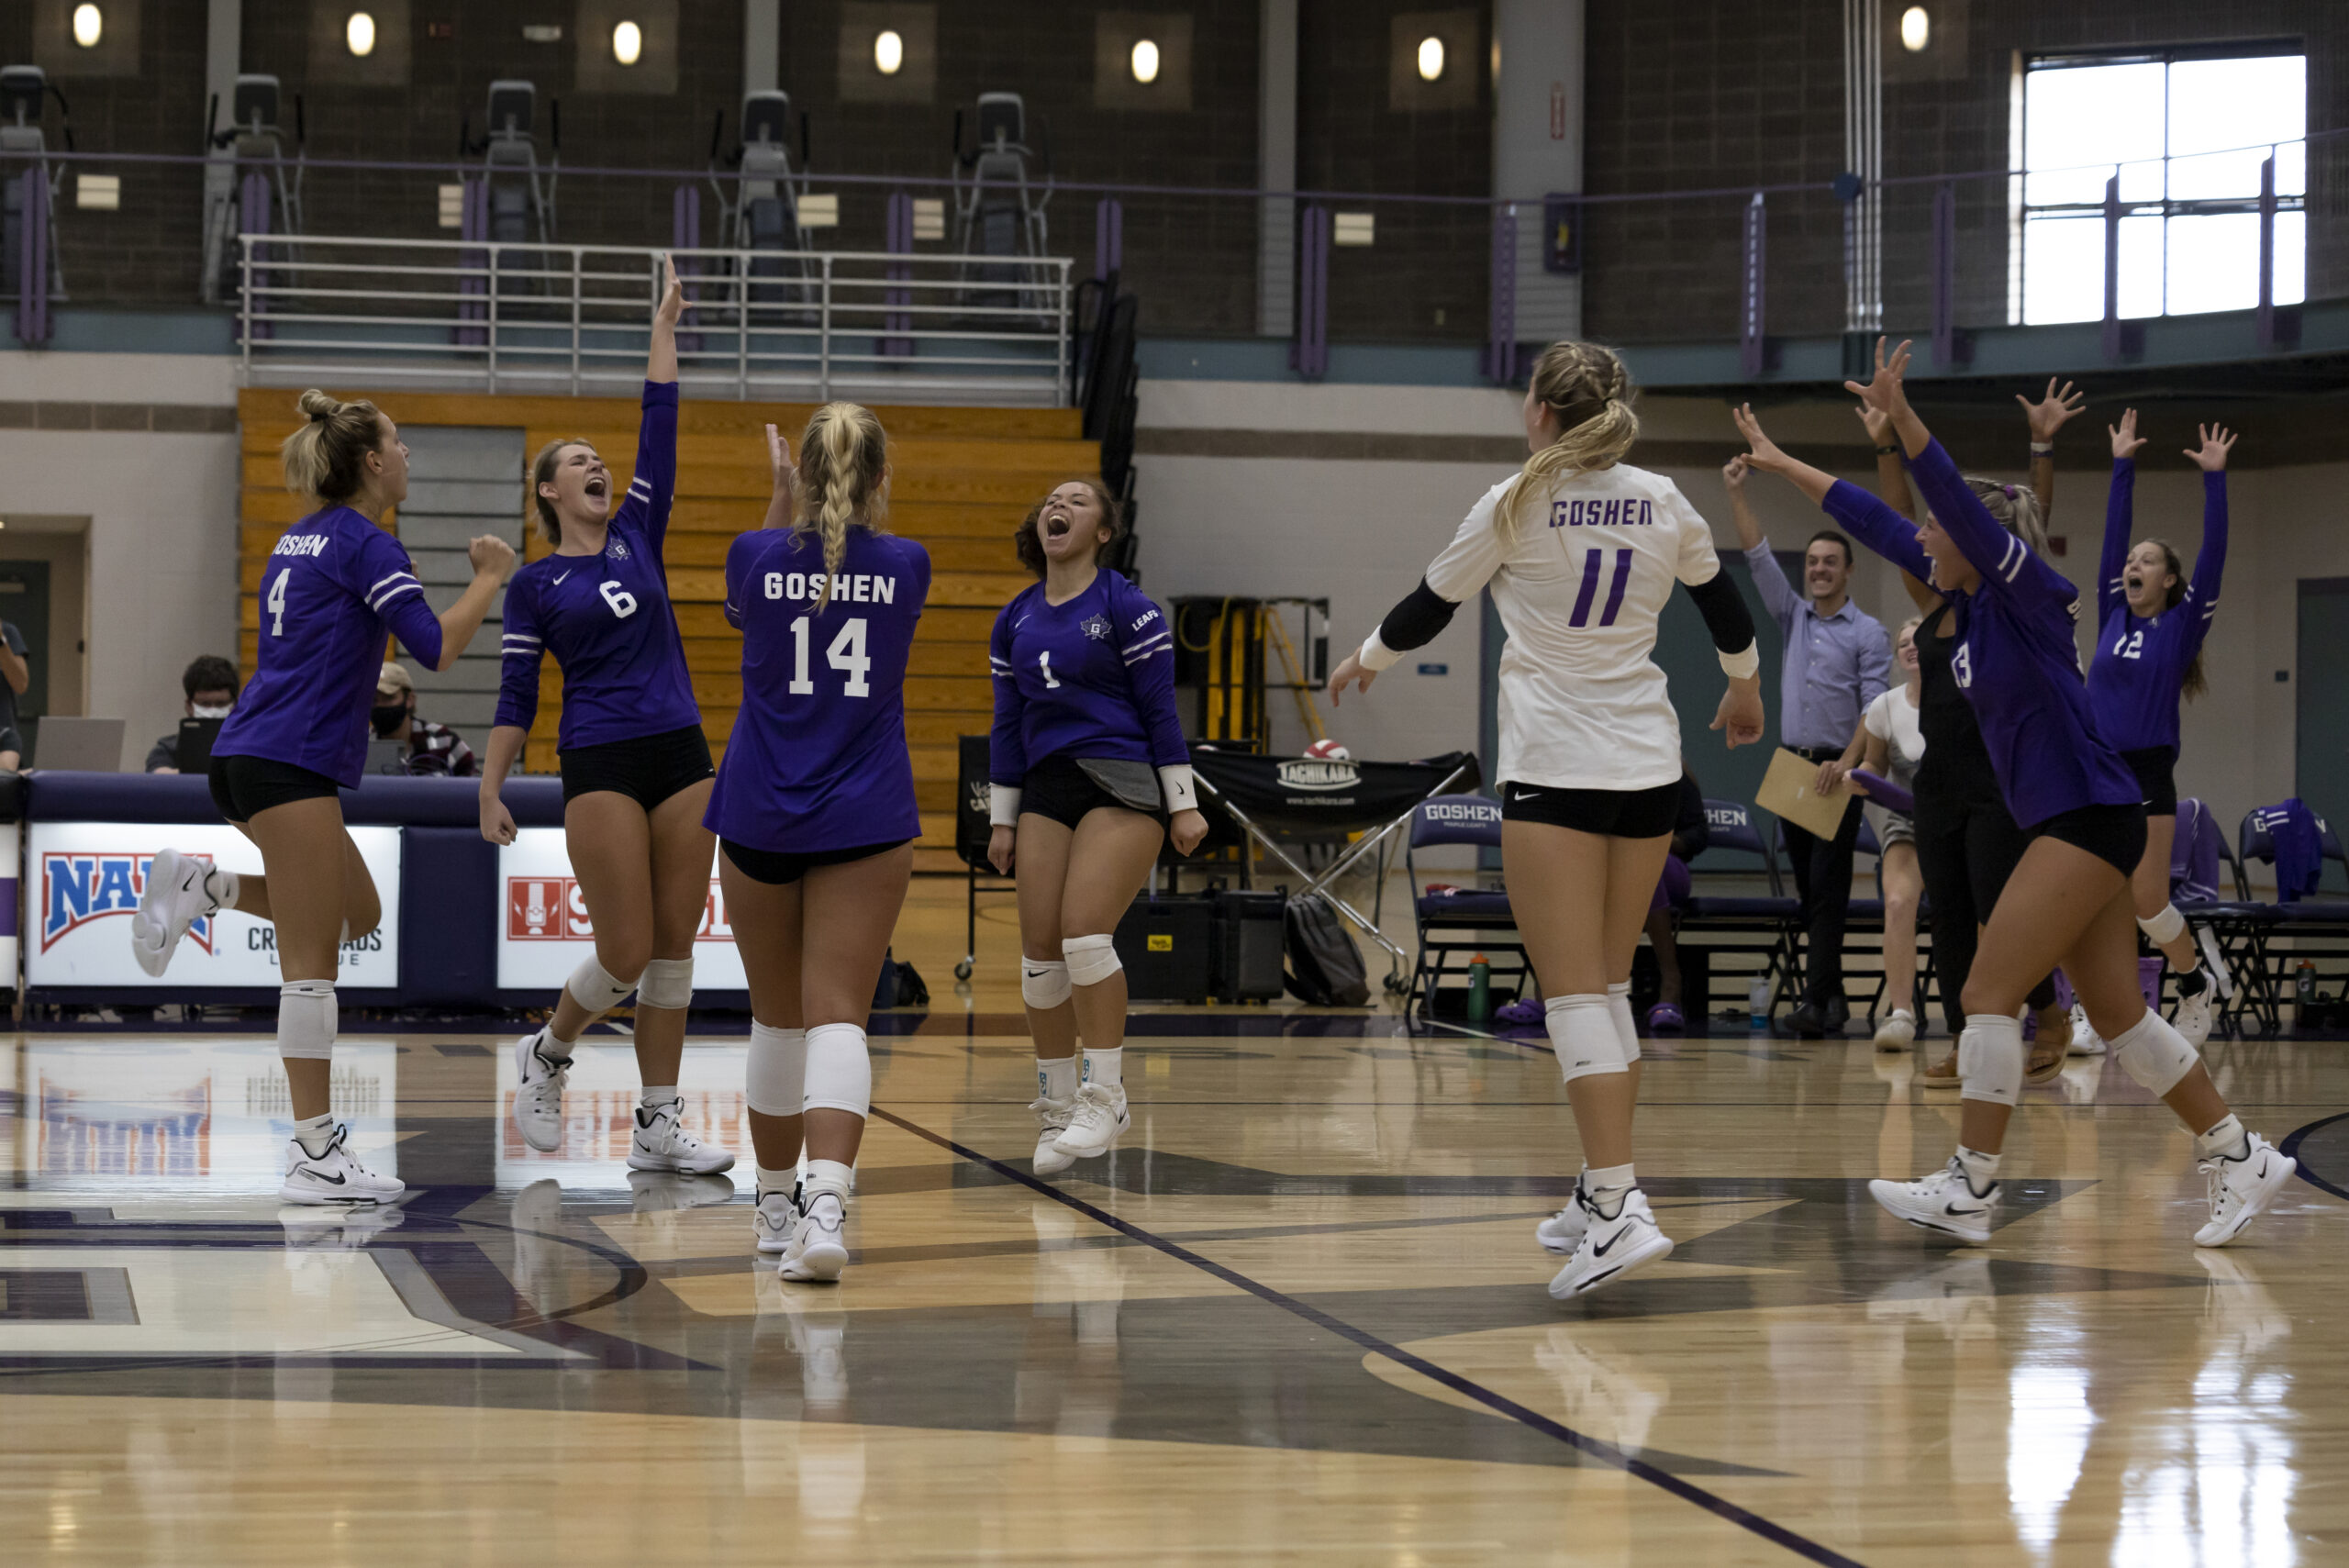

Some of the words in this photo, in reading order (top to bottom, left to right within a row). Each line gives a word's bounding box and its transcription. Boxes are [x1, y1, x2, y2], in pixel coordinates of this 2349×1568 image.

[1549, 499, 1653, 528] GOSHEN
[272, 534, 329, 558] OSHEN
[267, 568, 292, 637] 4
[598, 580, 638, 618] 6
[764, 572, 896, 605] GOSHEN
[1568, 549, 1633, 628] 11
[789, 616, 871, 698] 14
[2112, 630, 2144, 660] 12
[1039, 650, 1061, 689] 1
[1279, 762, 1358, 784] TACHIKARA
[1425, 804, 1503, 822] GOSHEN
